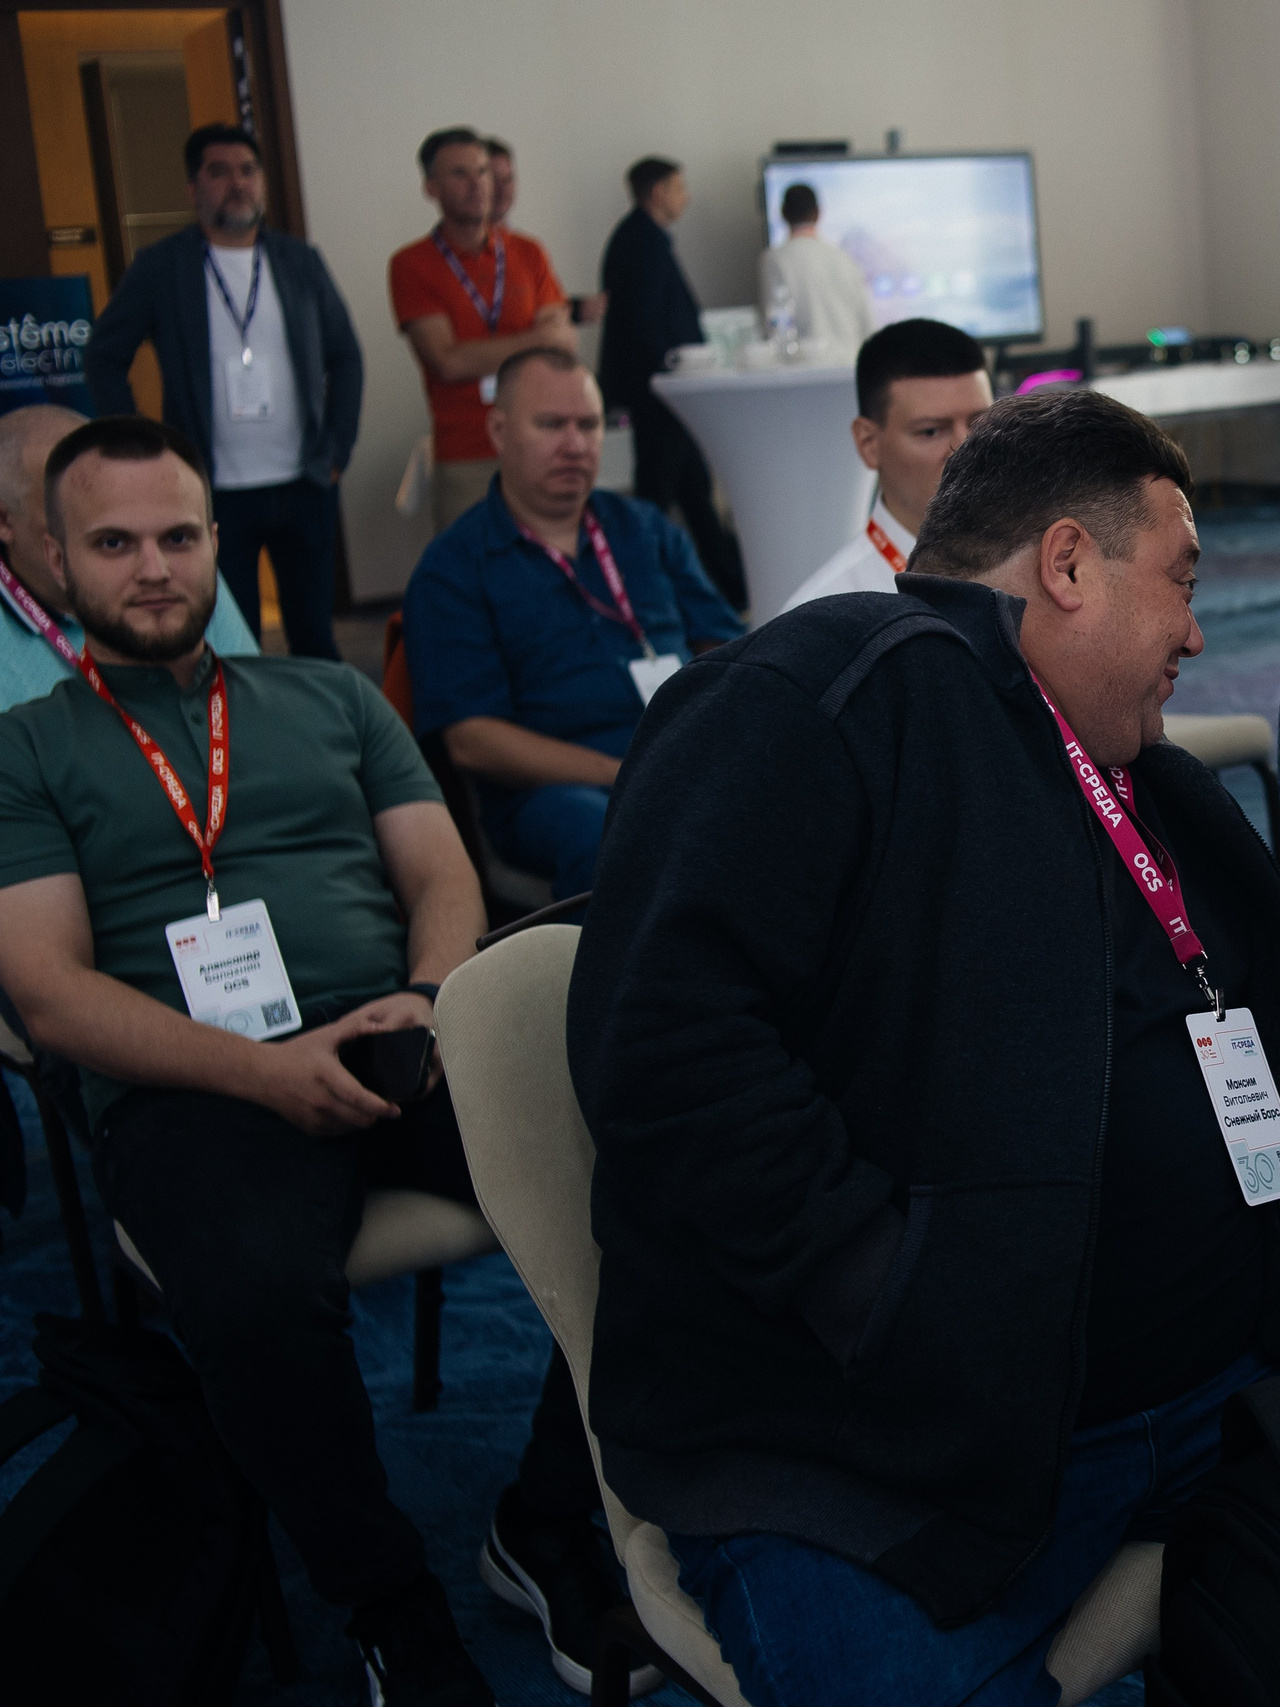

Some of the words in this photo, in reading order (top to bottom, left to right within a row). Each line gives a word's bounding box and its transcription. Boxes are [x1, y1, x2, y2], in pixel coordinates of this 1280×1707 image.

[1065, 741, 1123, 829] IT-СРЕДА
[1133, 853, 1163, 892] OCS
[1169, 916, 1187, 933] IT
[1231, 1039, 1256, 1050] IT-СРЕДА
[1225, 1077, 1257, 1091] Максим
[1223, 1090, 1269, 1107] Витальевич
[1224, 1109, 1261, 1128] Снежный
[1261, 1106, 1280, 1123] Барс
